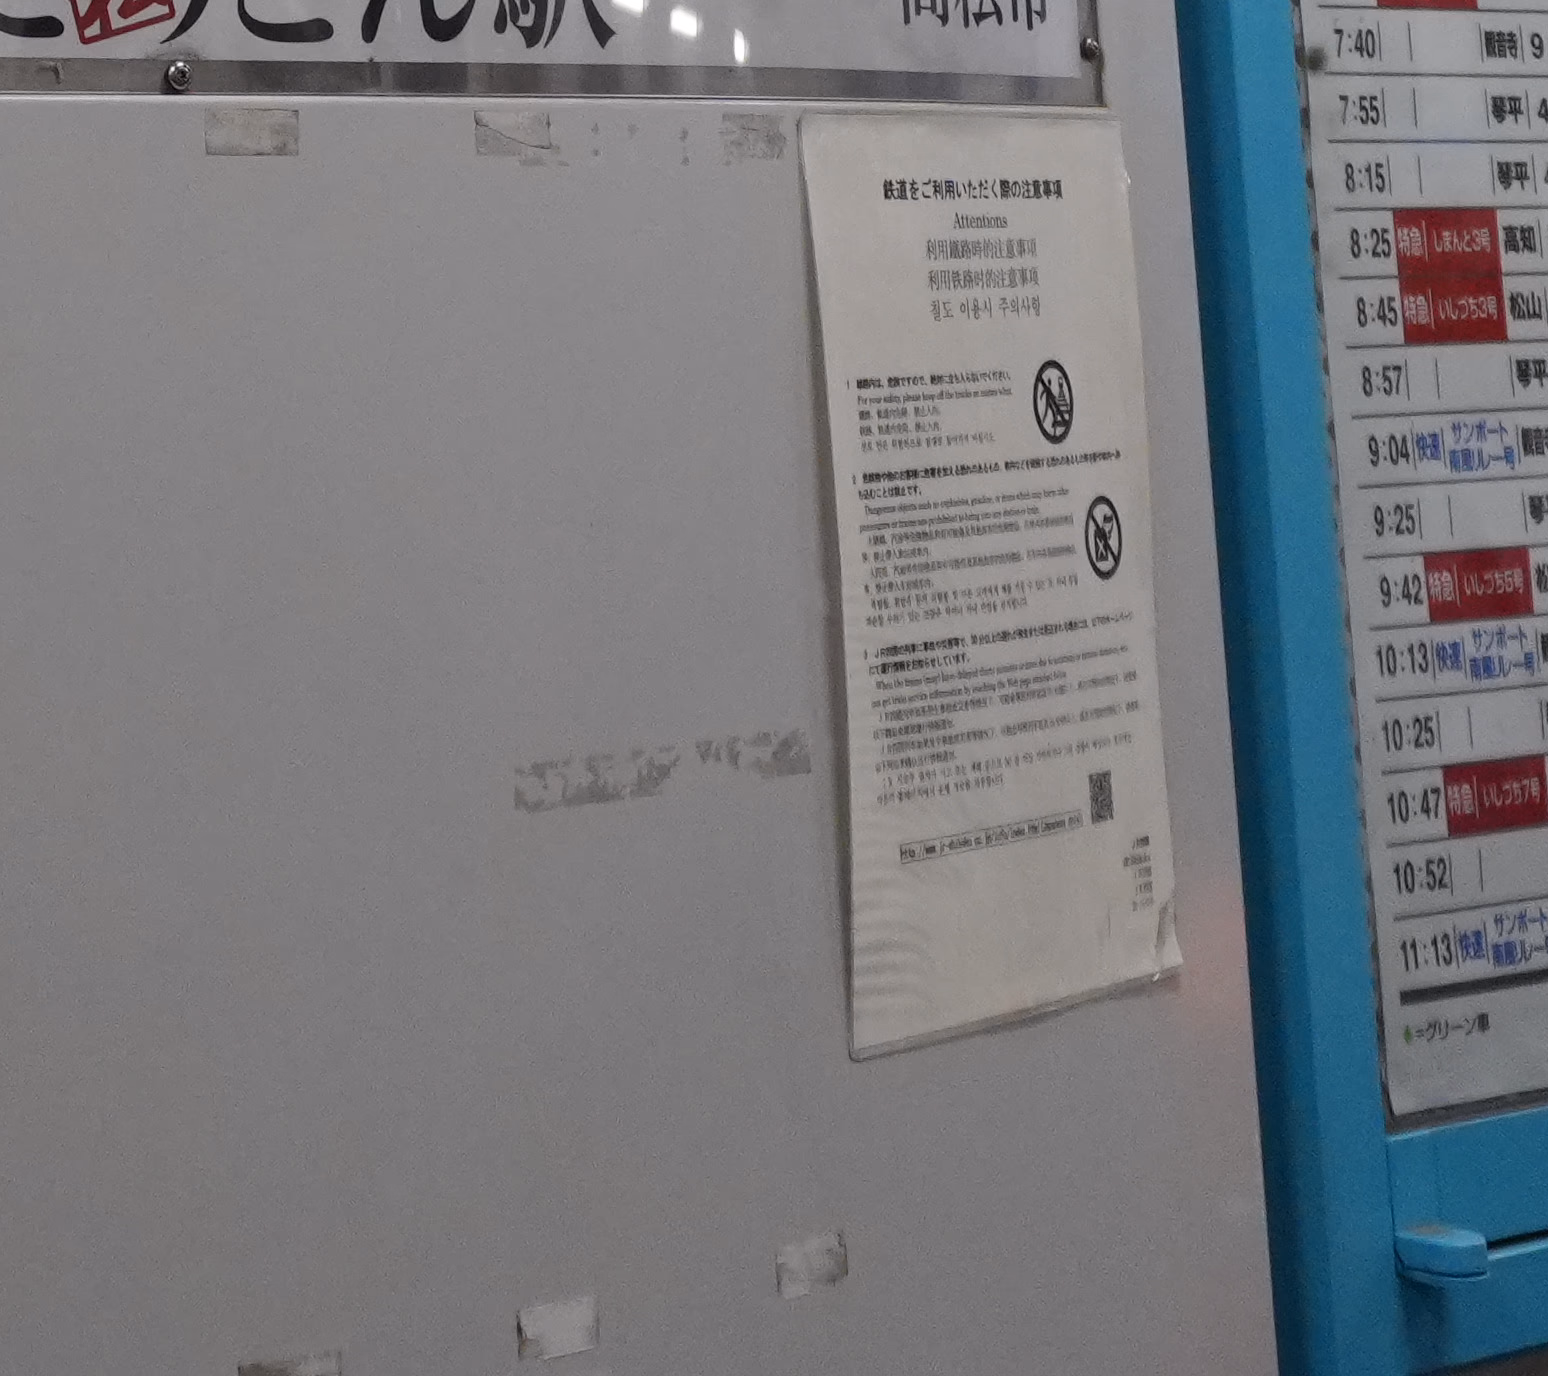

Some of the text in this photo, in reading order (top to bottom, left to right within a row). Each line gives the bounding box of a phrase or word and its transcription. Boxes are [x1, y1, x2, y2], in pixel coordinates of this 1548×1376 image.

[1334, 29, 1374, 59] 7:40
[1339, 95, 1380, 126] 7:55
[883, 178, 1063, 200] 鉄道をご利用いただく際の注意事項
[1345, 163, 1386, 193] 8:15
[953, 212, 1008, 229] Attentions
[1350, 228, 1391, 258] 8:25
[1357, 297, 1397, 328] 8:45
[1362, 366, 1402, 397] 8:57
[1369, 435, 1410, 466] 9:04
[1374, 504, 1416, 536] 9:25
[1380, 574, 1423, 607] 9:42
[1376, 640, 1429, 676] 10:13
[1382, 717, 1435, 751] 10:25
[1388, 787, 1441, 823] 10:47
[1393, 857, 1448, 894] 10:52
[1401, 933, 1452, 971] 11:13
